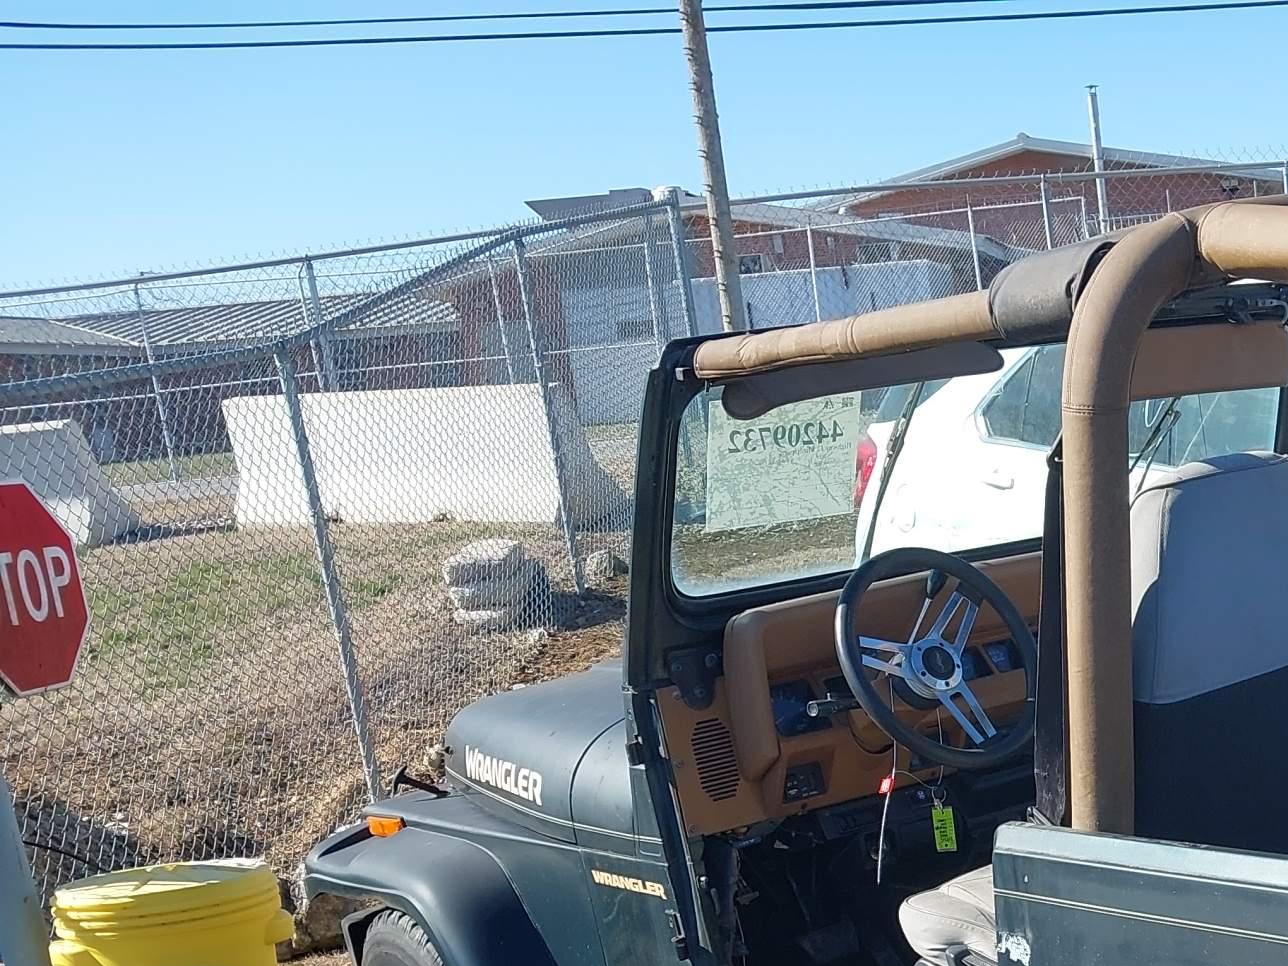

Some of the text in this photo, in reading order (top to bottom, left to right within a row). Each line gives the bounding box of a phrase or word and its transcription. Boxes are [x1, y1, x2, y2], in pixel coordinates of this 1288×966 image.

[0, 546, 72, 627] TOP
[465, 745, 543, 807] WRANGLER
[591, 869, 668, 901] WRANGLER
